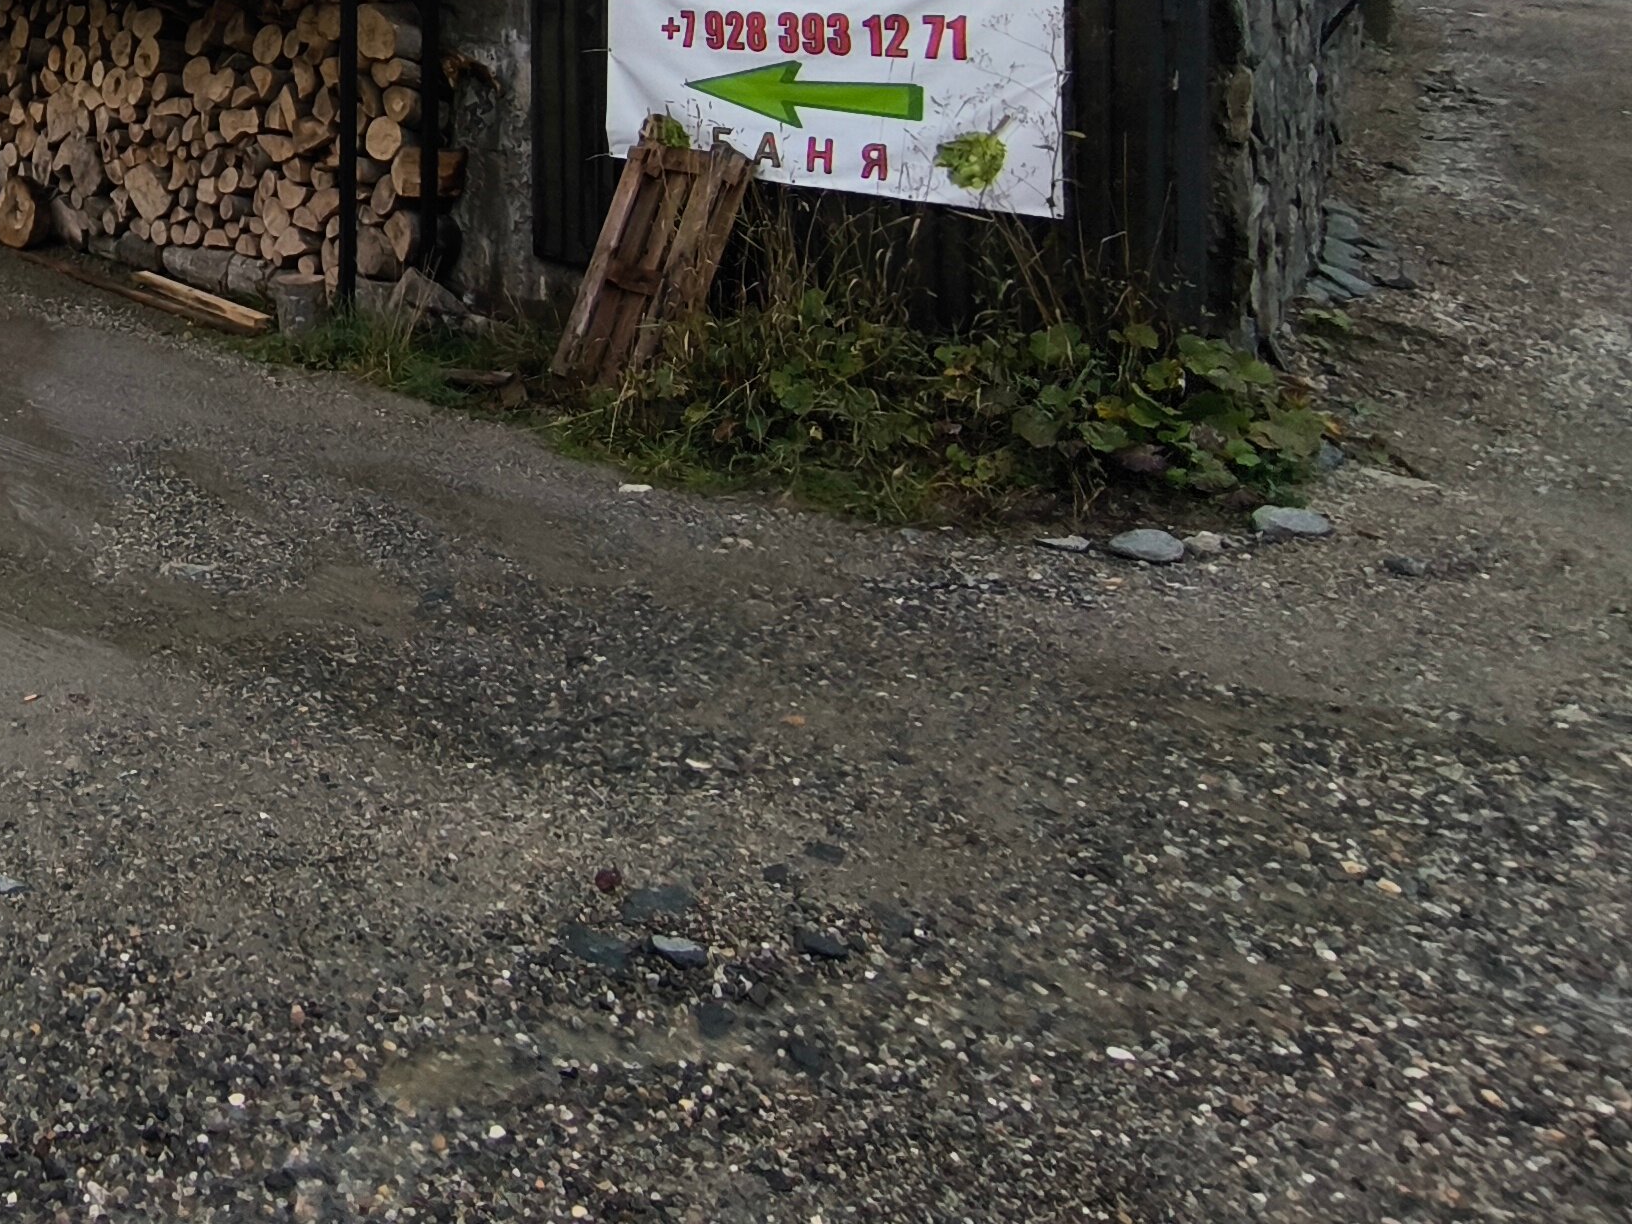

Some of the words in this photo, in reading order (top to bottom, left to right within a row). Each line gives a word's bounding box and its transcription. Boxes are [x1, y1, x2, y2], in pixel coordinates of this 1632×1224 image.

[661, 10, 696, 49] +7
[705, 10, 767, 52] 928
[778, 11, 851, 56] 393
[863, 14, 909, 59] 12
[922, 15, 968, 61] 71
